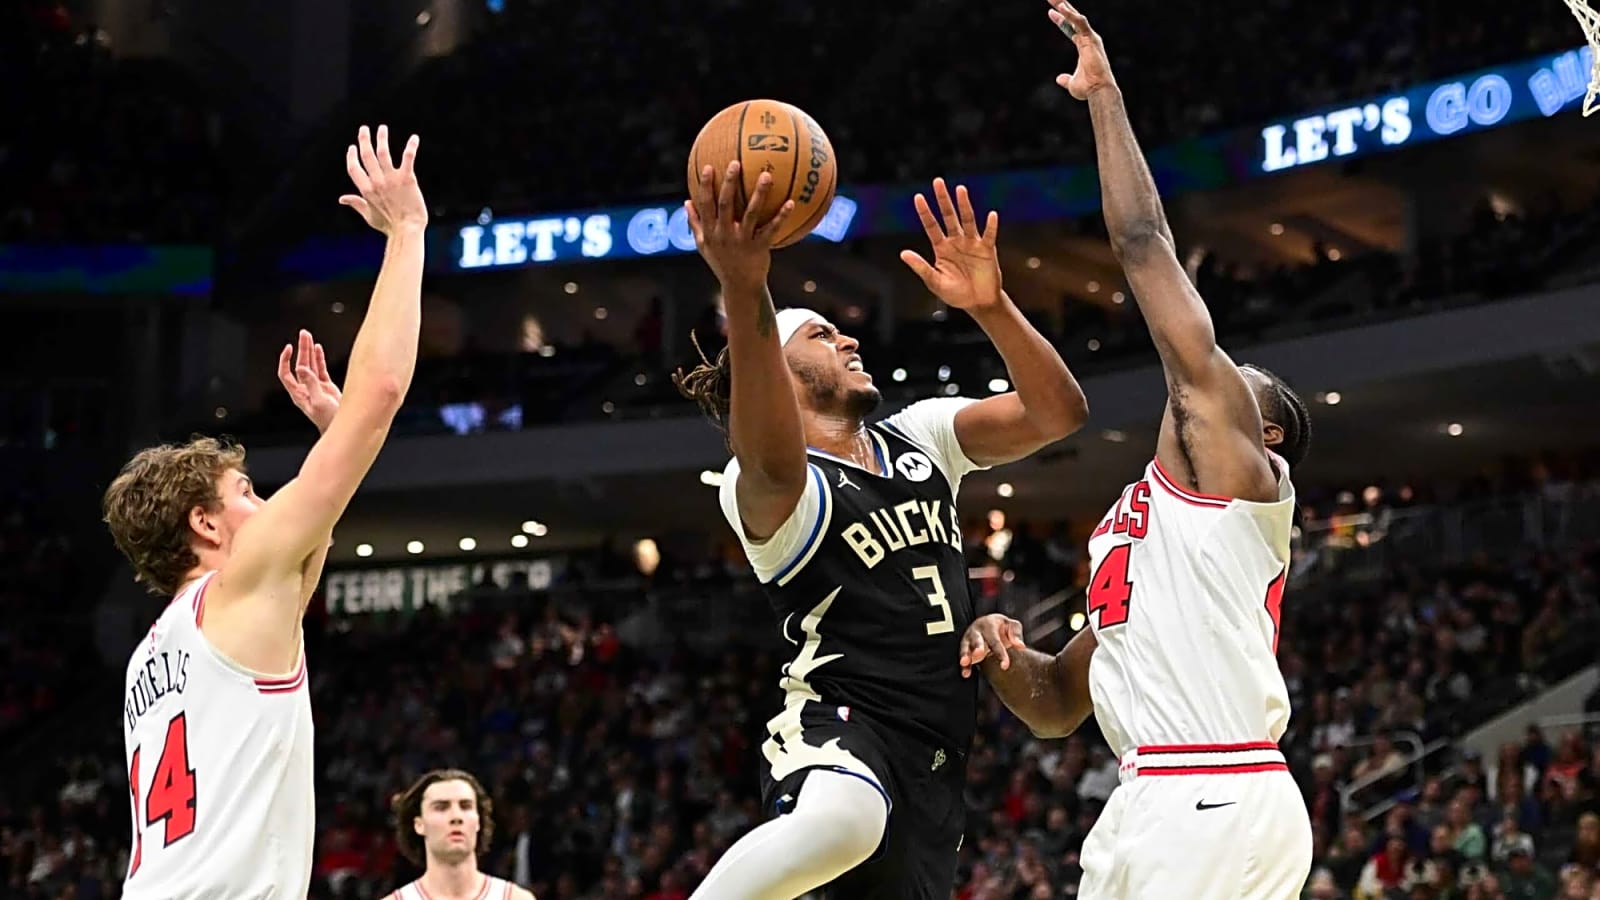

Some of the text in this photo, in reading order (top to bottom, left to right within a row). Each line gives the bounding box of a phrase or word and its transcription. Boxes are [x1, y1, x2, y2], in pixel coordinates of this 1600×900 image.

[1262, 96, 1412, 171] LET'S
[1425, 74, 1512, 135] GO
[458, 214, 612, 268] LET'S
[841, 500, 963, 569] BUCKS
[325, 570, 404, 614] FEAR
[912, 565, 955, 636] 3
